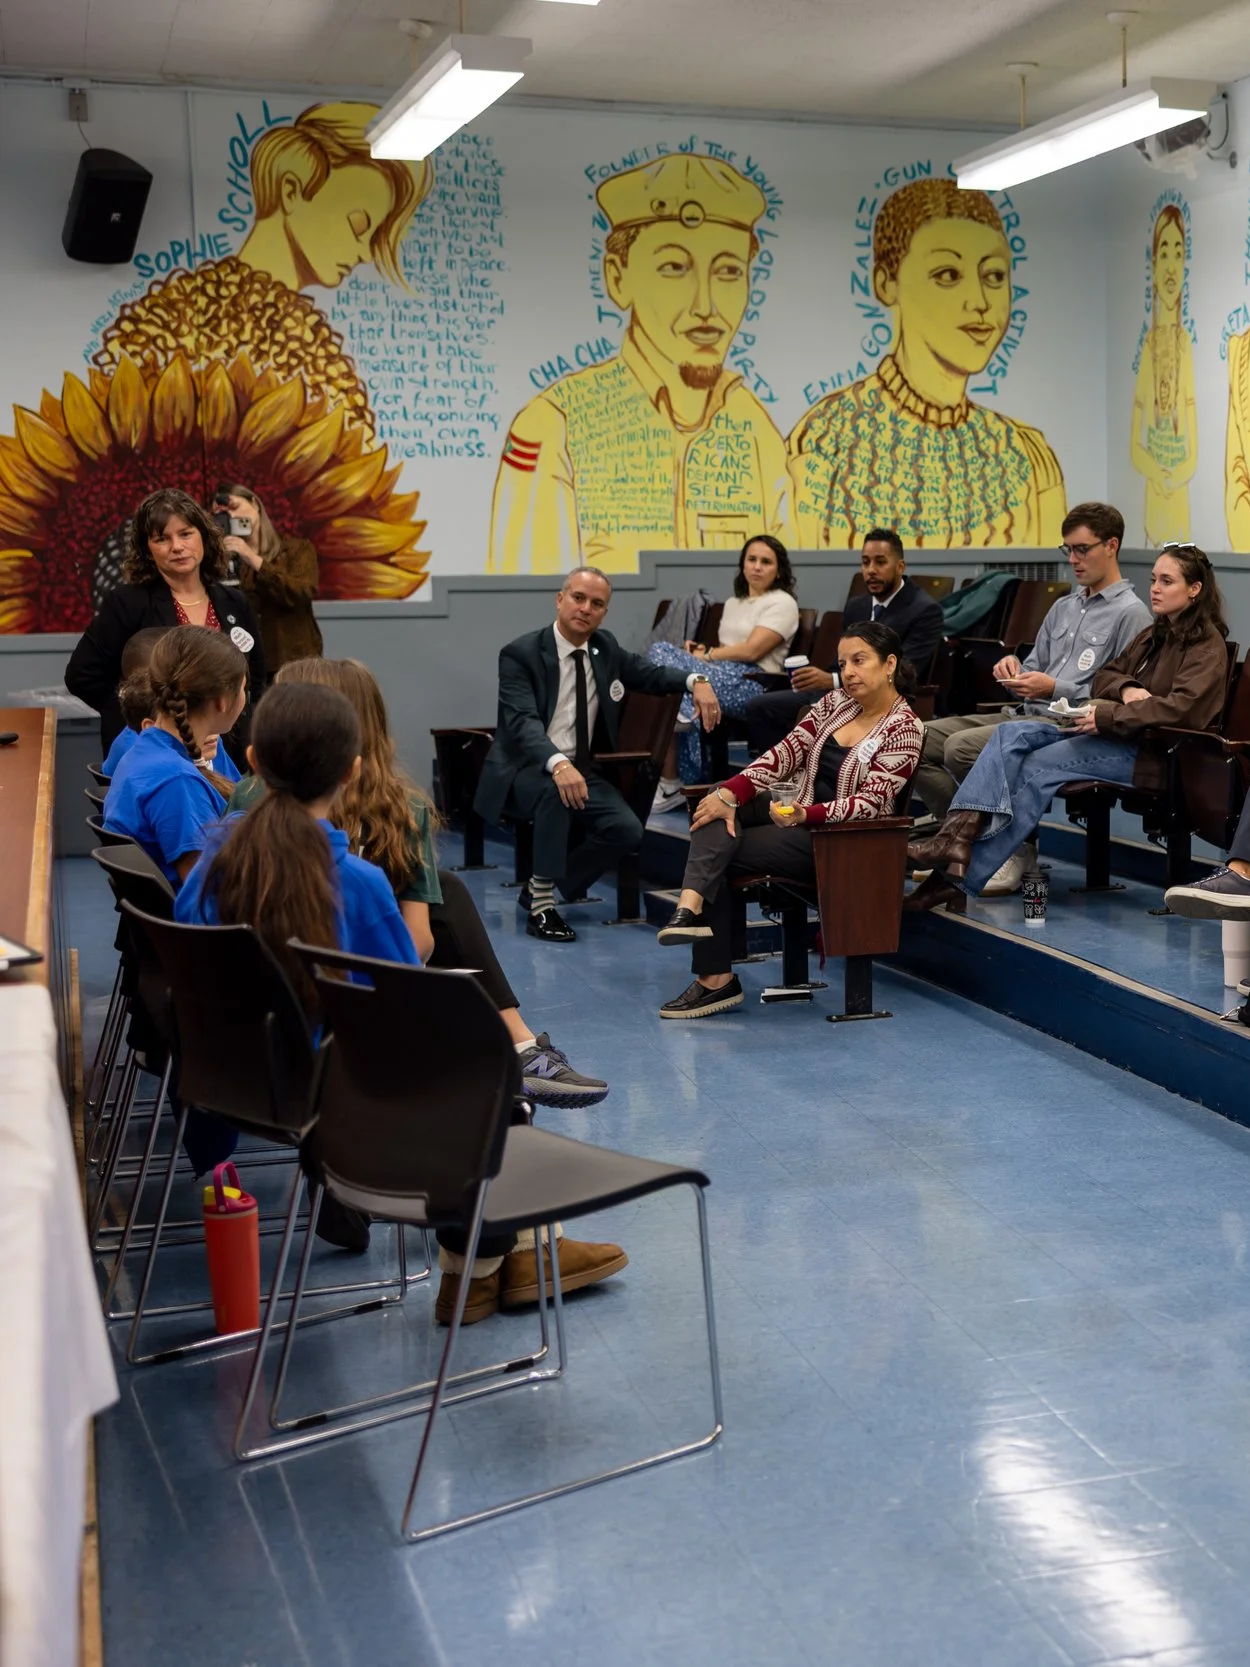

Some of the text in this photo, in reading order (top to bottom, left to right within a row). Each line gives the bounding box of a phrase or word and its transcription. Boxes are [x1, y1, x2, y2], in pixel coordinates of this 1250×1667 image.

[584, 142, 671, 185] FOUNDER
[704, 140, 738, 163] THE
[133, 100, 293, 279] SOPHIE SCHOLL
[448, 242, 464, 255] to
[402, 254, 436, 273] left
[802, 361, 868, 405] EMMA
[851, 197, 894, 359] GONZALEZ
[883, 159, 932, 187] GUN
[970, 285, 1030, 395] ACTIVIST
[1219, 302, 1250, 361] GRETA
[437, 345, 483, 360] take
[574, 335, 618, 370] CHA
[359, 358, 430, 375] measure
[435, 358, 453, 375] of
[529, 355, 576, 390] CHA
[727, 330, 780, 405] PARTY
[414, 391, 457, 408] fear
[464, 393, 488, 408] of
[863, 388, 887, 414] SO
[378, 405, 500, 433] antagonizing
[438, 427, 480, 441] own
[695, 429, 751, 454] PUERTO
[688, 447, 751, 470] RICANS
[687, 467, 753, 485] DEMAND
